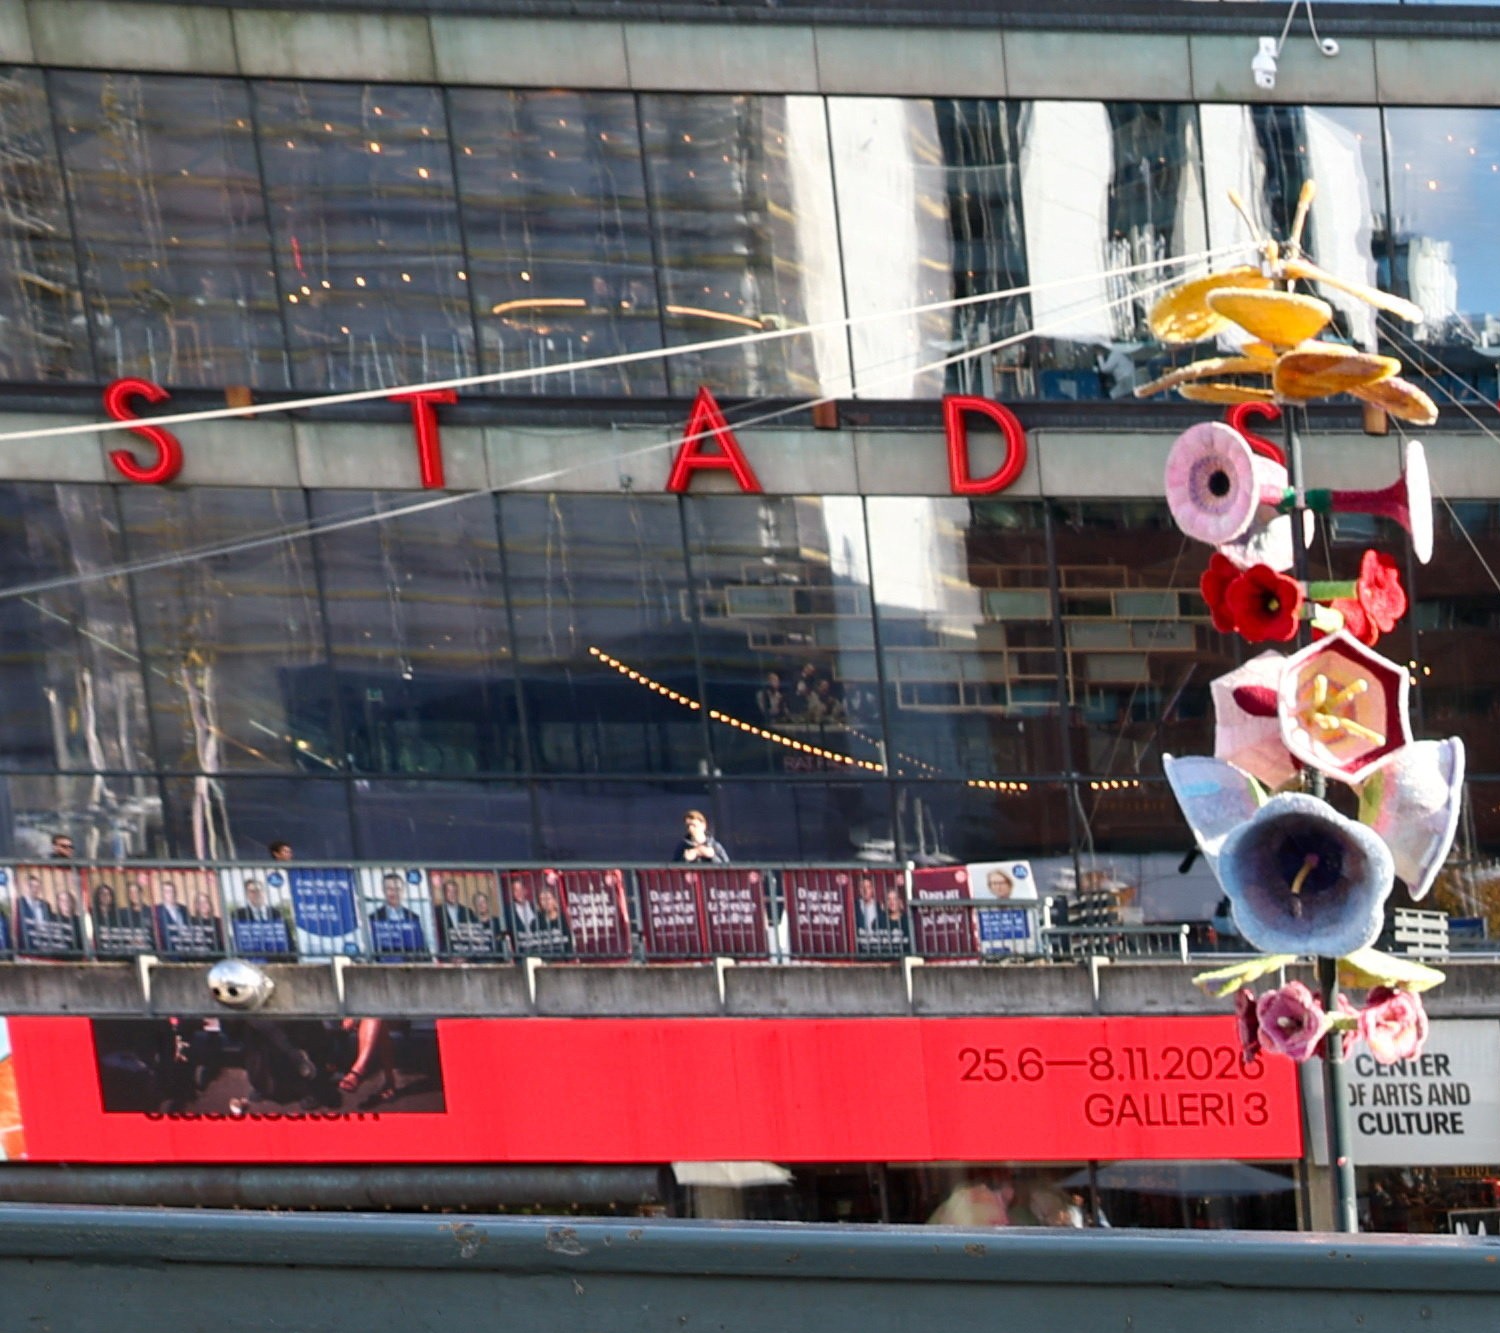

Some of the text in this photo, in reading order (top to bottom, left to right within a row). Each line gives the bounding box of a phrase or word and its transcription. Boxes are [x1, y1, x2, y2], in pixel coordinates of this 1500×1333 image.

[1373, 1083, 1423, 1106] ARTS
[1428, 1083, 1472, 1106] AND
[1086, 1092, 1269, 1127] GALLERI 3
[1358, 1111, 1465, 1136] CULTURE
